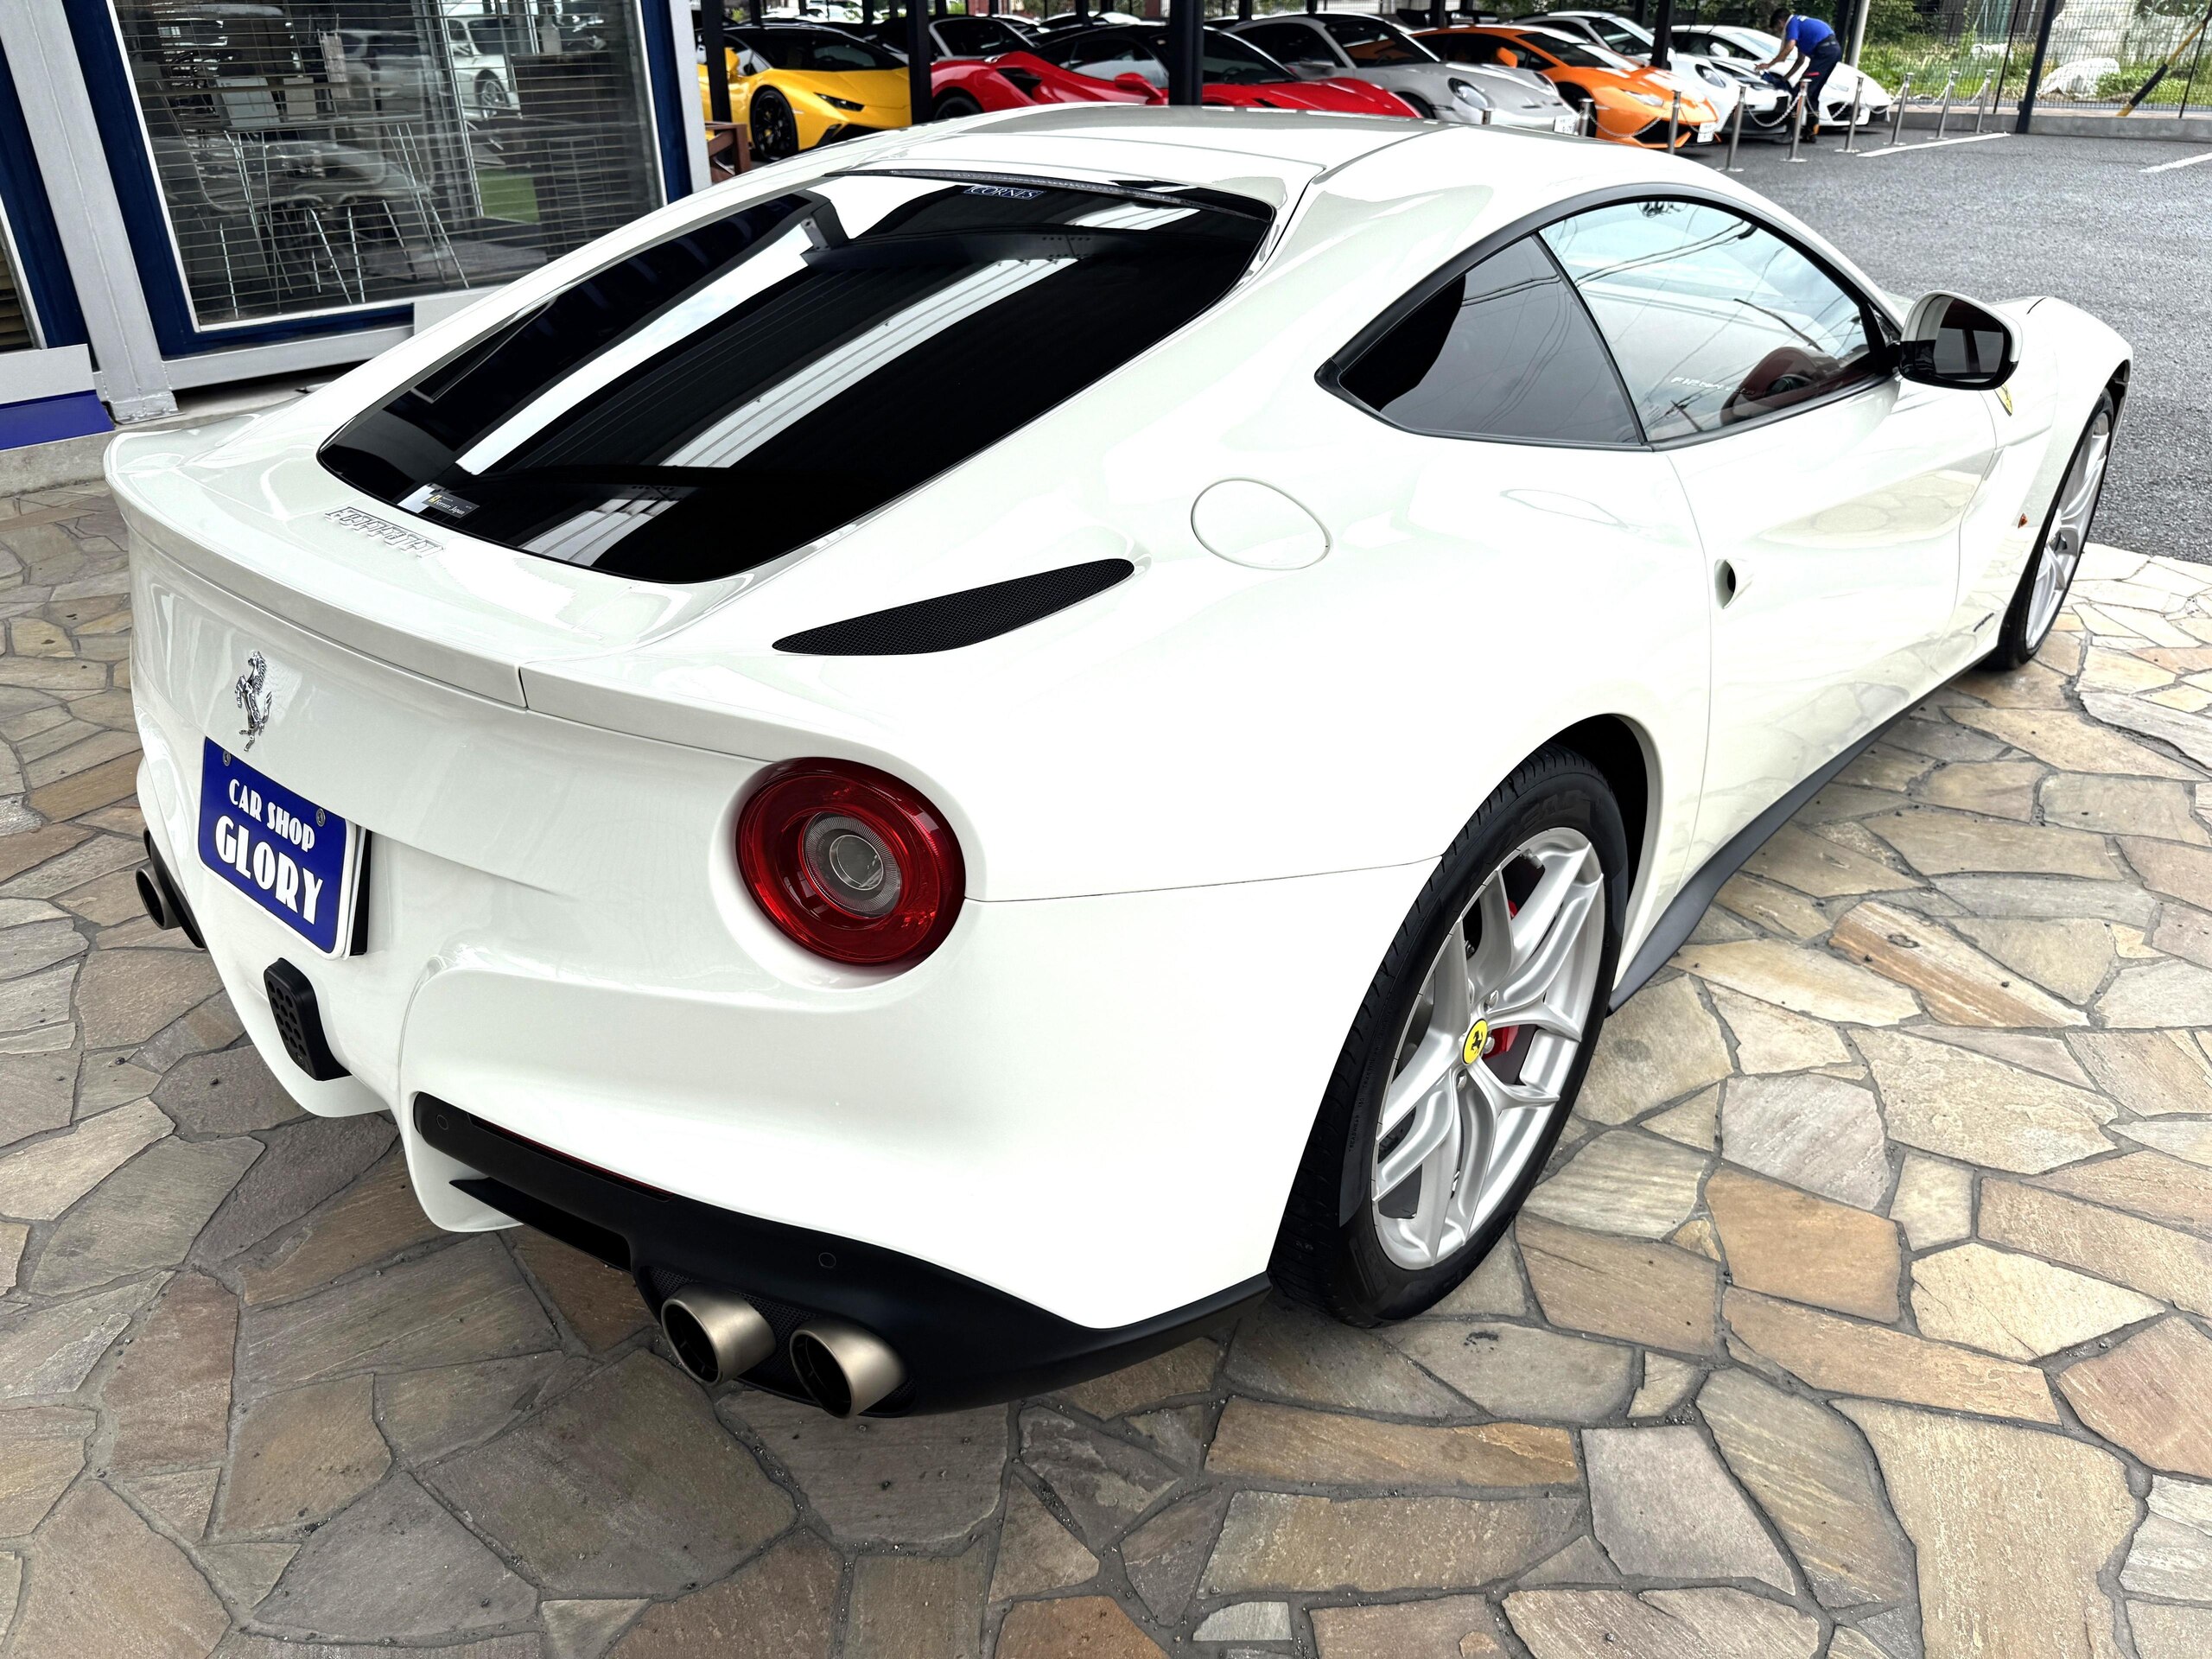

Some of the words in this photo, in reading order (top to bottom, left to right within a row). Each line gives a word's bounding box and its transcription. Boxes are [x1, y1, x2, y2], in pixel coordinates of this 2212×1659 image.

[324, 506, 444, 558] Ferrari
[434, 499, 451, 510] Ferrari
[449, 505, 466, 515] Japan
[228, 779, 263, 822] CAR
[266, 801, 315, 853] SHOP
[215, 815, 324, 925] GLORY
